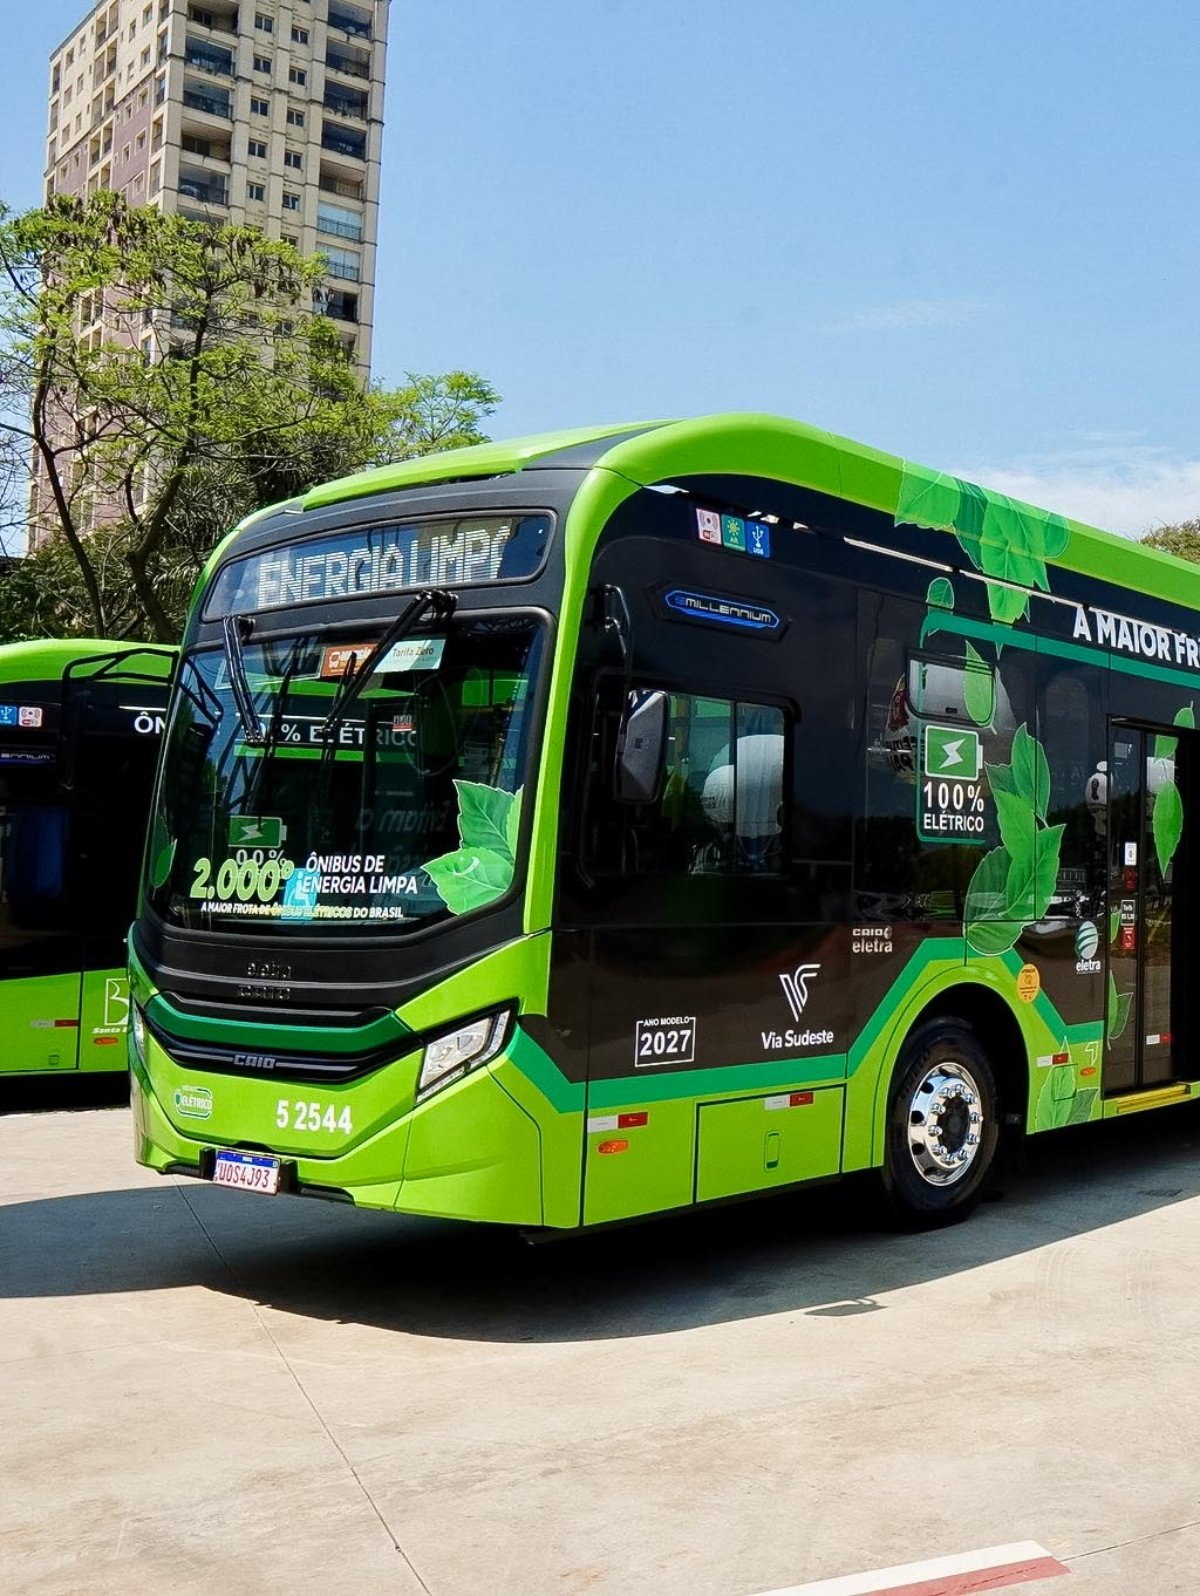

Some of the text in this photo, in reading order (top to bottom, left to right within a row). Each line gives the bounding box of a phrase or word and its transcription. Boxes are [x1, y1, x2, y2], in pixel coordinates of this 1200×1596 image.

[257, 543, 404, 608] ENERGIA
[1073, 607, 1091, 642] A
[1096, 611, 1171, 660] MAIOR
[924, 811, 984, 833] ELÉTRICO
[306, 852, 362, 872] ÔNIBUS
[364, 855, 385, 872] DE
[303, 876, 418, 894] ENERGIA LIMPA
[201, 903, 208, 912] A
[208, 903, 233, 914] MAIOR
[233, 904, 259, 915] FROTA
[260, 904, 271, 915] DE
[353, 907, 367, 918] DO
[369, 906, 404, 919] BRASIL
[852, 938, 893, 953] eletra
[1076, 958, 1101, 972] eletra
[92, 1026, 121, 1035] Santa
[644, 1015, 690, 1027] ANO MODELO
[640, 1030, 692, 1056] 2027
[762, 1029, 834, 1050] Via Sudeste
[276, 1099, 352, 1134] 5 2544
